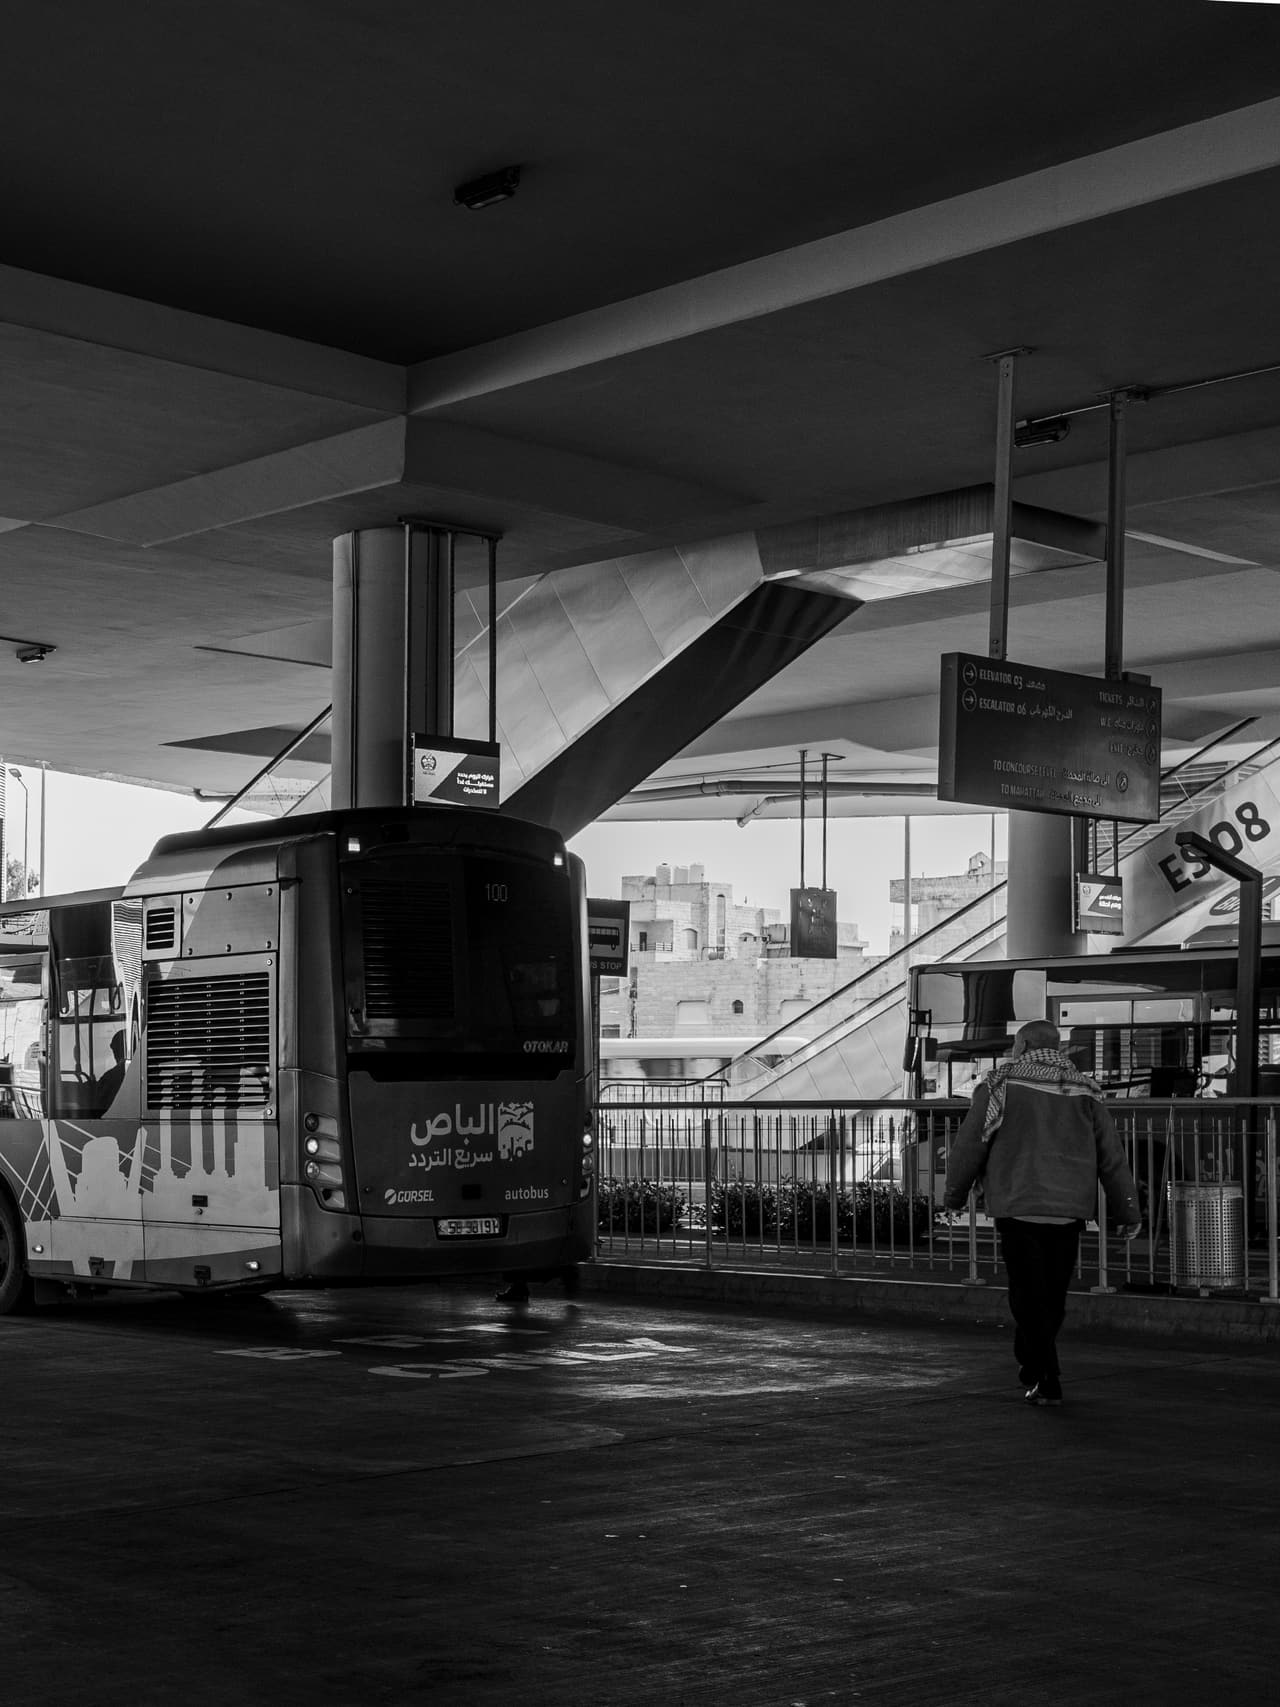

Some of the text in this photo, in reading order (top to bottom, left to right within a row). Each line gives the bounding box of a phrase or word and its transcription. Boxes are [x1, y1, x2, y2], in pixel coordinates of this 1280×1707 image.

[979, 669, 1023, 690] ELEVATOR 03
[979, 697, 1027, 716] ESCALATOR 06
[993, 760, 1002, 770] TO
[1002, 761, 1039, 776] CONCOURSE
[486, 883, 508, 901] 100
[600, 961, 622, 970] STOP
[523, 1041, 568, 1053] OTOKAR
[410, 1103, 495, 1146] الباص
[408, 1148, 493, 1171] سريع التردد
[505, 1187, 549, 1200] autobus
[367, 1337, 699, 1379] ONLY
